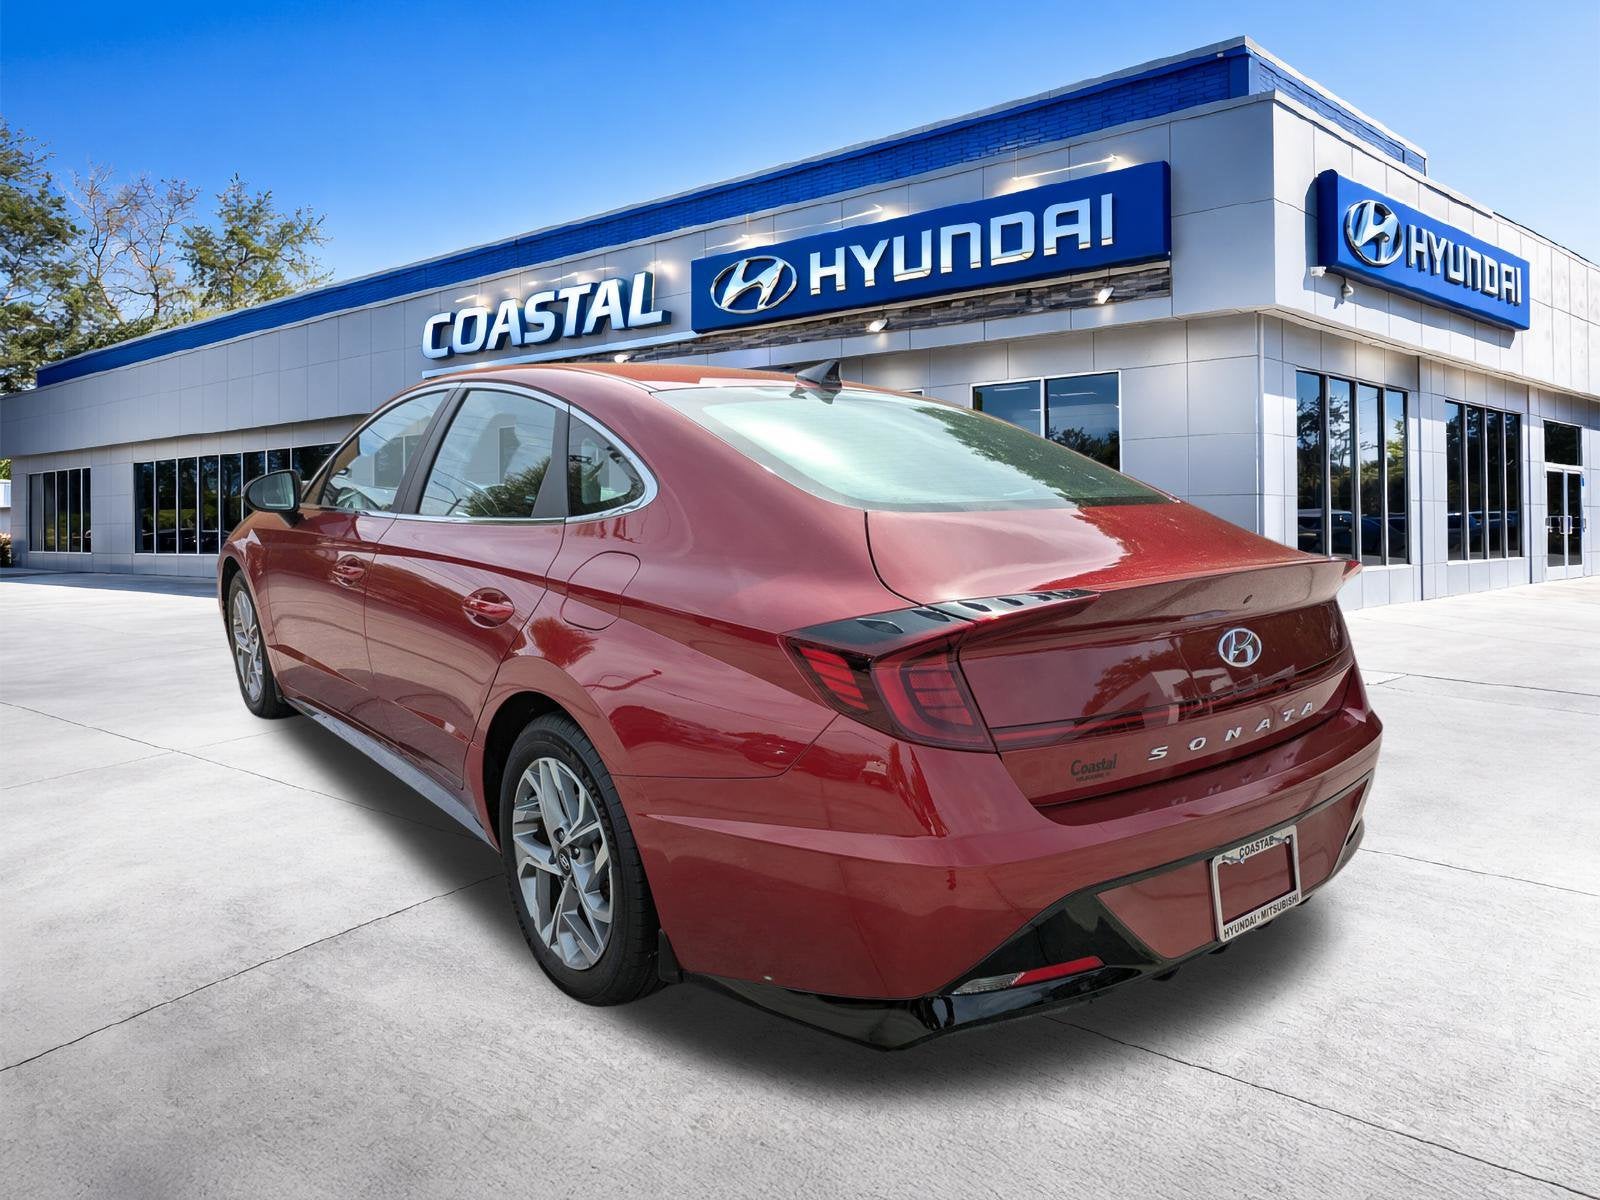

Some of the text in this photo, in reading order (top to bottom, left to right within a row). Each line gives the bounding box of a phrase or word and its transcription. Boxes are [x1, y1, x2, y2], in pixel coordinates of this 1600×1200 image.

[809, 192, 1113, 296] HYUNDAI
[1405, 223, 1522, 307] HYUNDAI
[422, 271, 668, 360] COASTAL
[1070, 752, 1118, 777] Coastal
[1148, 702, 1313, 761] SONATA
[1223, 893, 1299, 939] HYUNDAI MITSUBISHI
